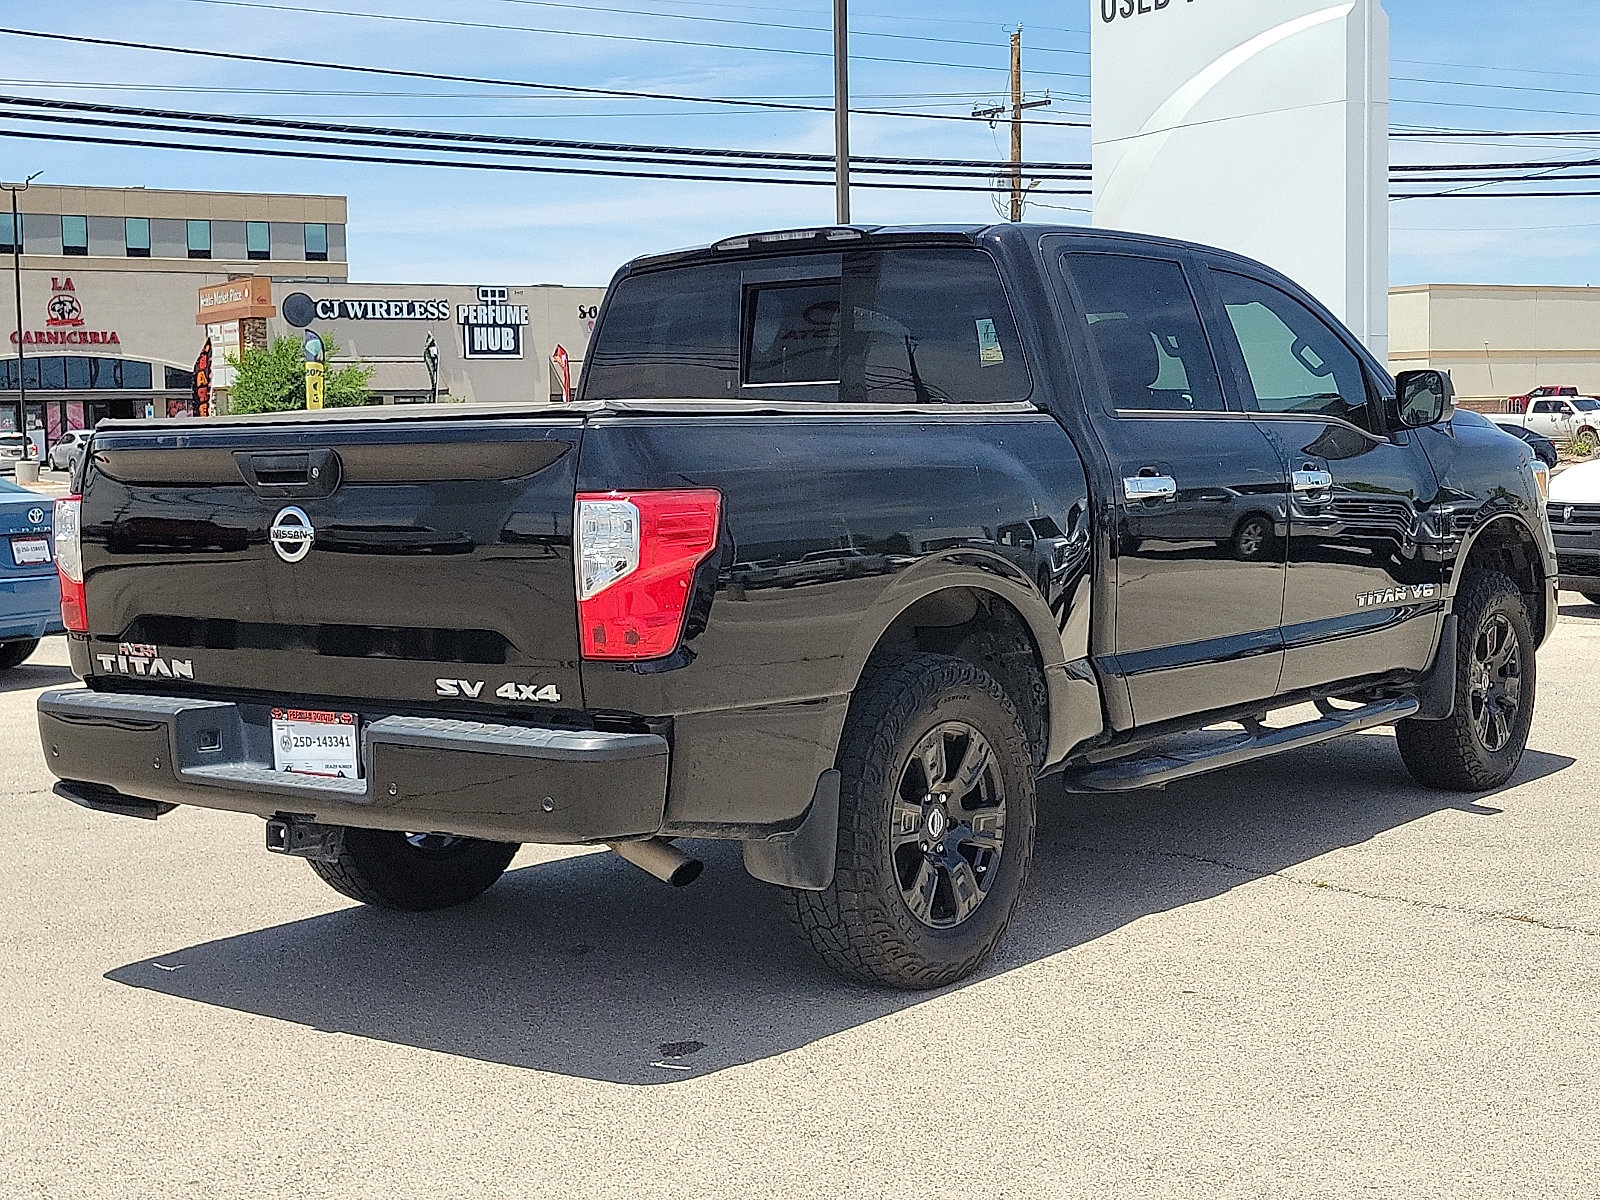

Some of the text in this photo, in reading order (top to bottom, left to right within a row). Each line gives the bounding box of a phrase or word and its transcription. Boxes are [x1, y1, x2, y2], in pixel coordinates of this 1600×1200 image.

[51, 277, 76, 291] LA
[316, 300, 451, 320] CJ WIRELESS
[457, 304, 530, 325] PERFUME
[9, 330, 121, 345] CARNICERIA
[473, 327, 516, 351] HUB
[272, 529, 308, 539] NISSAN
[1356, 586, 1408, 607] TITAN
[96, 653, 195, 680] TITAN
[435, 678, 485, 698] SV
[292, 735, 351, 748] 25D-143341
